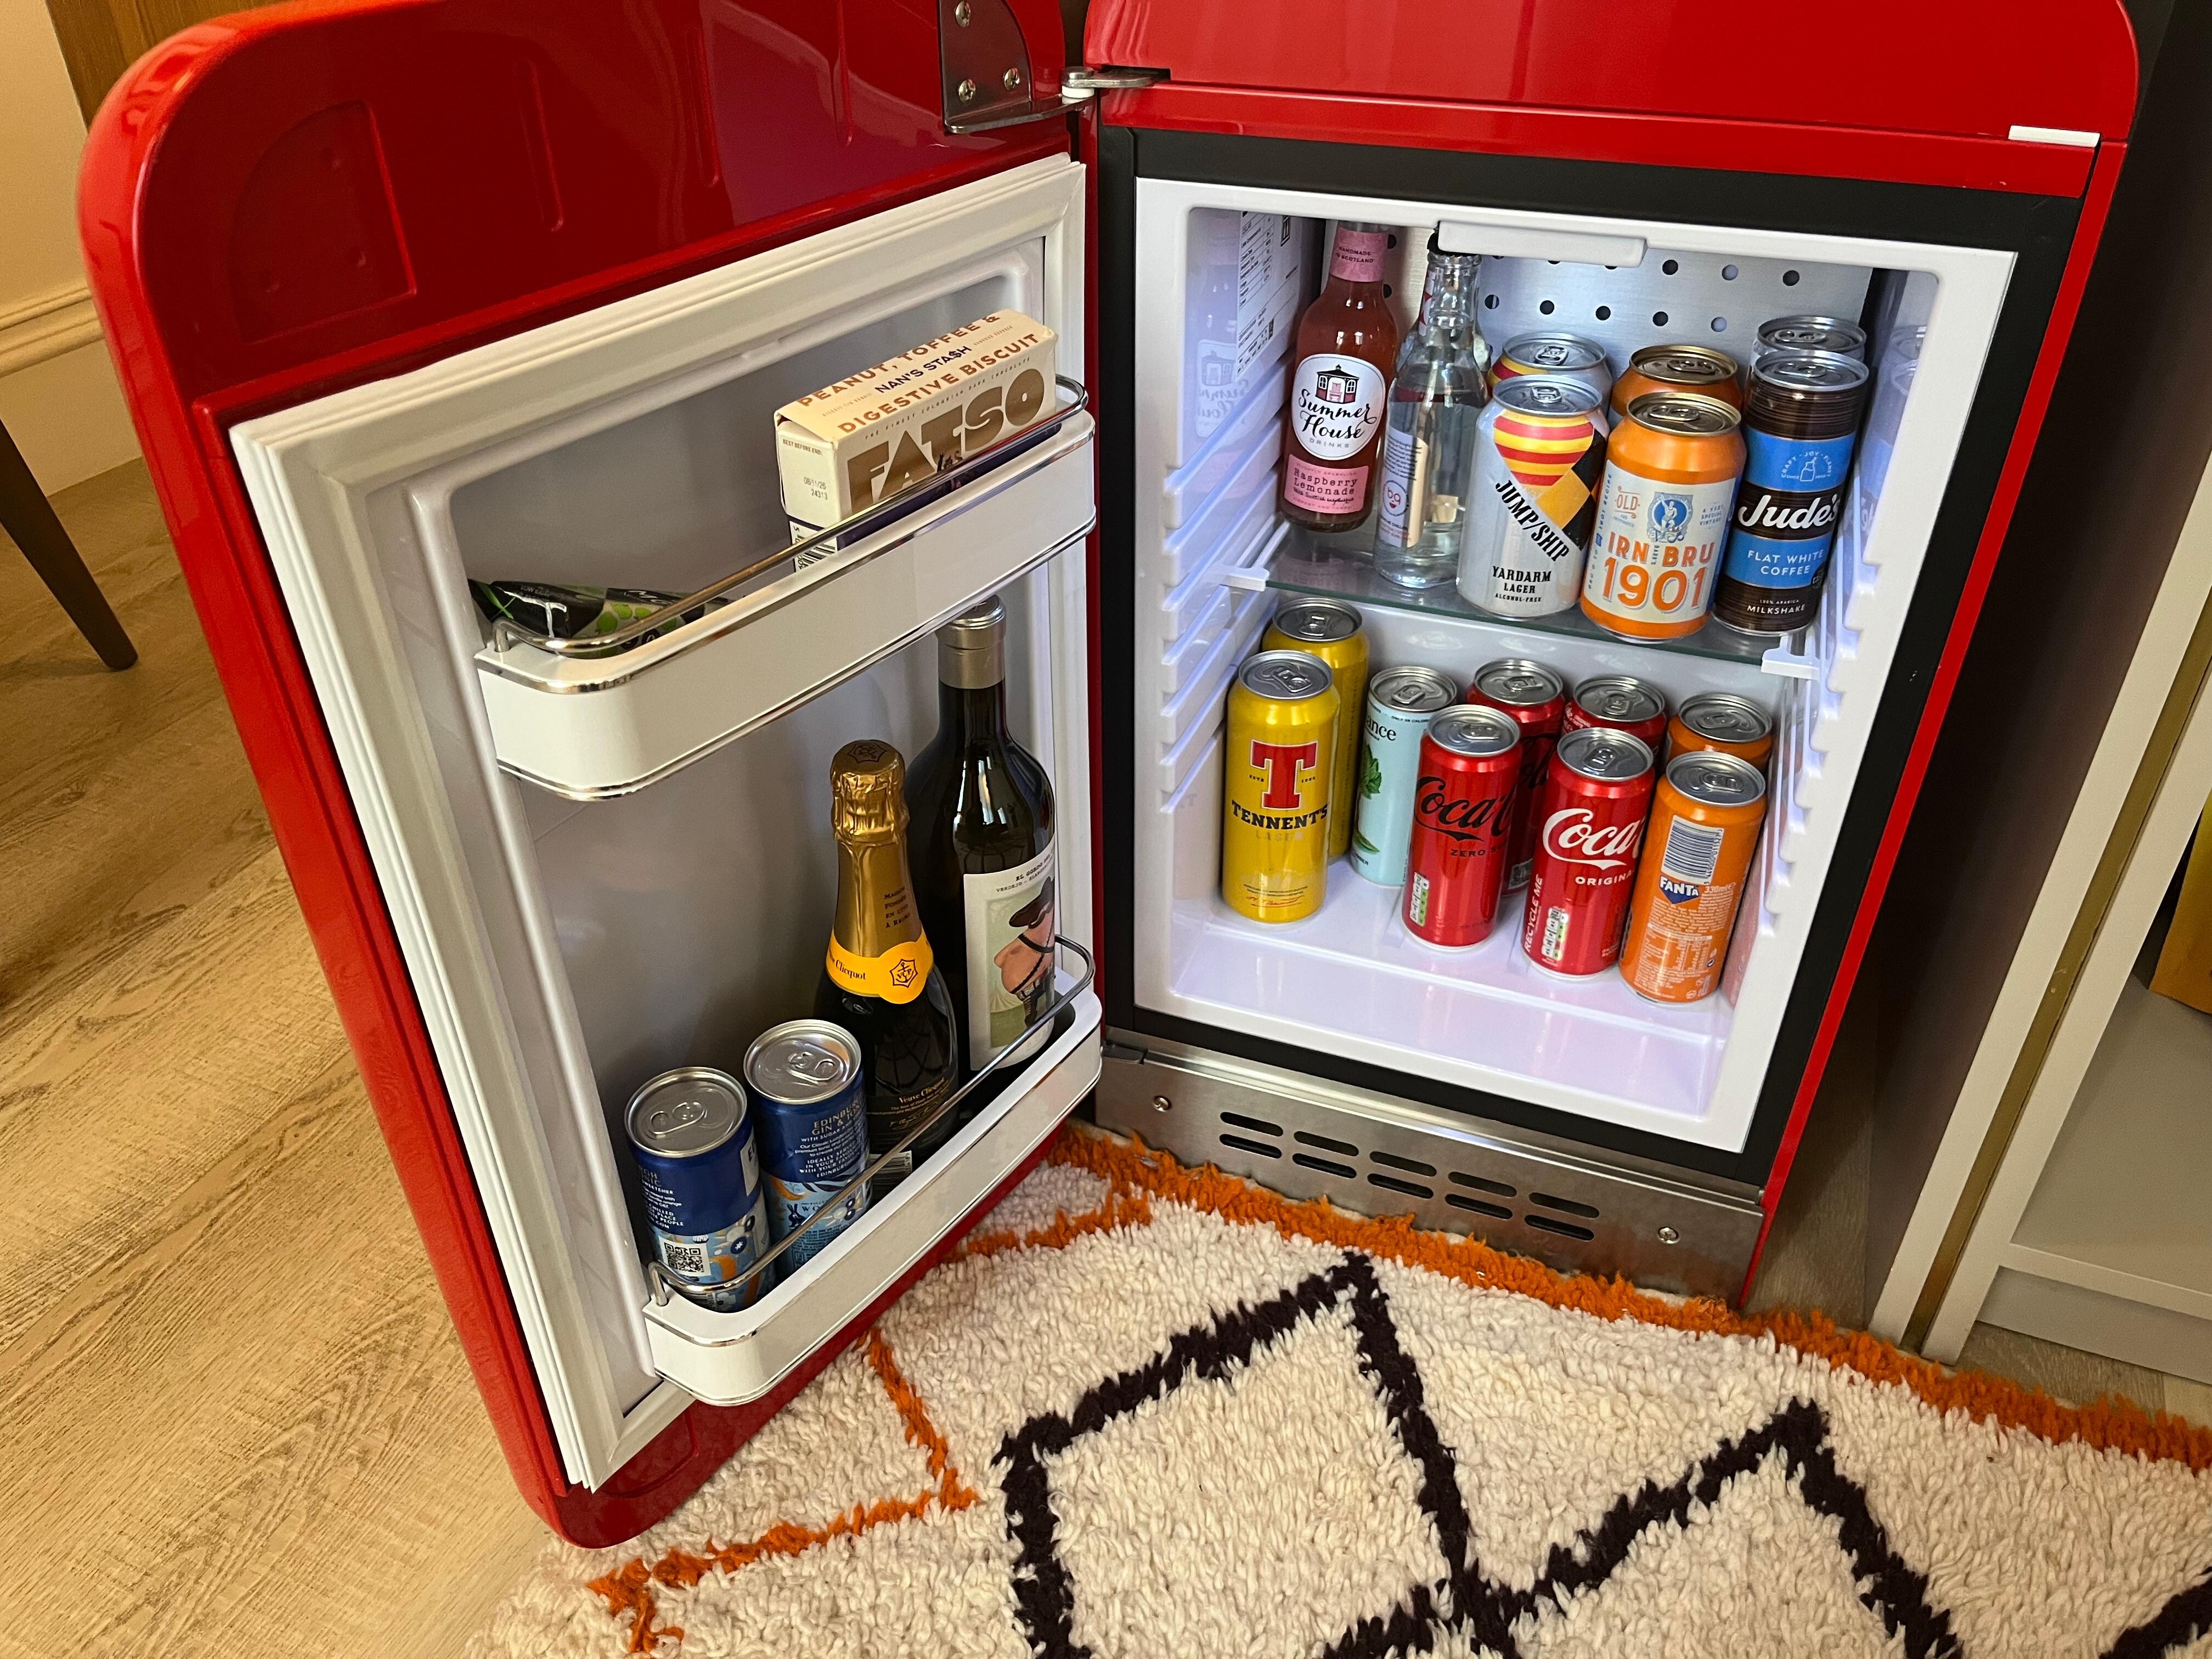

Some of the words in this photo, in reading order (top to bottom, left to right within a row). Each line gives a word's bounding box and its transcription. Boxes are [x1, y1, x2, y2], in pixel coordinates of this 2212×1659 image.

[1339, 246, 1371, 256] HANDMADE
[1341, 255, 1374, 263] SCOTLAND
[898, 324, 981, 361] TOFFEE
[837, 374, 960, 433] DIGESTIVE
[958, 334, 1039, 376] BISCUIT
[874, 369, 924, 393] NAN'S
[1299, 388, 1378, 425] Summer
[1300, 410, 1365, 439] House
[794, 441, 811, 453] BEFORE
[847, 369, 1045, 514] FATSO
[1310, 438, 1350, 448] DRINKS
[1294, 467, 1358, 487] Raspberry
[1294, 477, 1355, 495] Lemonade
[1616, 494, 1639, 511] OLD
[1701, 512, 1722, 520] SPECIAL
[1737, 494, 1841, 529] Jude's
[1495, 479, 1570, 562] JUMP/SHIP
[1607, 531, 1650, 565] IRN
[1662, 541, 1716, 567] BRU
[1747, 550, 1781, 563] FLAT
[1787, 549, 1825, 565] WHITE
[1492, 566, 1552, 583] YARDARM
[1760, 565, 1810, 576] COFFEE
[1503, 582, 1536, 594] LAGER
[1602, 556, 1708, 614] 1901
[1494, 593, 1542, 602] ALCOHOL-FREE
[1747, 604, 1806, 614] MILKSHAKE
[1250, 739, 1319, 810] T
[1231, 799, 1329, 830] TENNENT'S
[1450, 848, 1486, 858] ZERO
[1015, 873, 1024, 882] EL
[996, 882, 1023, 892] VERDEJO
[1660, 876, 1699, 896] FANTA
[1524, 895, 1539, 953] RECYCLE
[1533, 873, 1543, 897] ME
[836, 960, 866, 980] Clicquot
[811, 1124, 833, 1136] GIN
[820, 1128, 840, 1139] SUGAR
[807, 1154, 833, 1164] IDEALLY
[815, 1159, 834, 1167] YOUR
[819, 1162, 837, 1171] YOUR
[660, 1217, 684, 1227] PEOPLE
